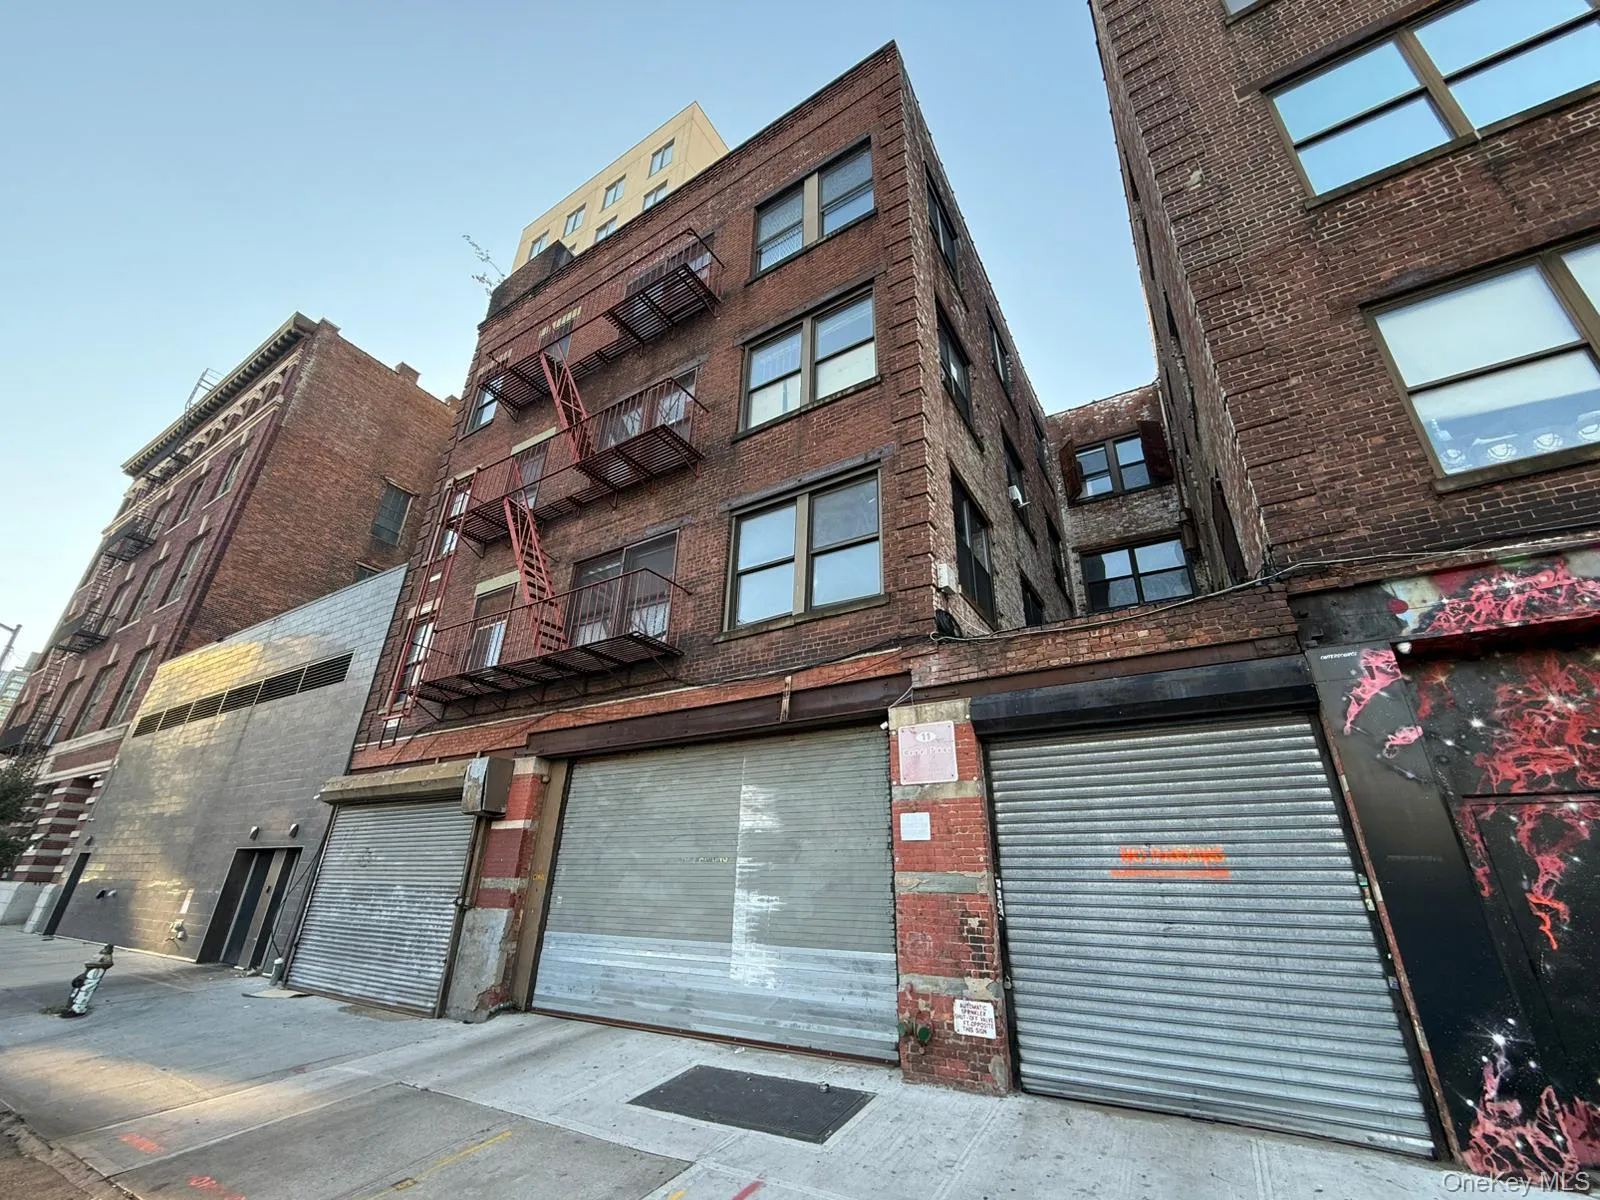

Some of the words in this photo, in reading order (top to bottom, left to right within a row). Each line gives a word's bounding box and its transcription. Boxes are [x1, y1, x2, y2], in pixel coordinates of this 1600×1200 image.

[1119, 846, 1147, 864] NO
[960, 1002, 987, 1010] AUTOMATIC
[960, 1008, 986, 1016] SPRINKLER
